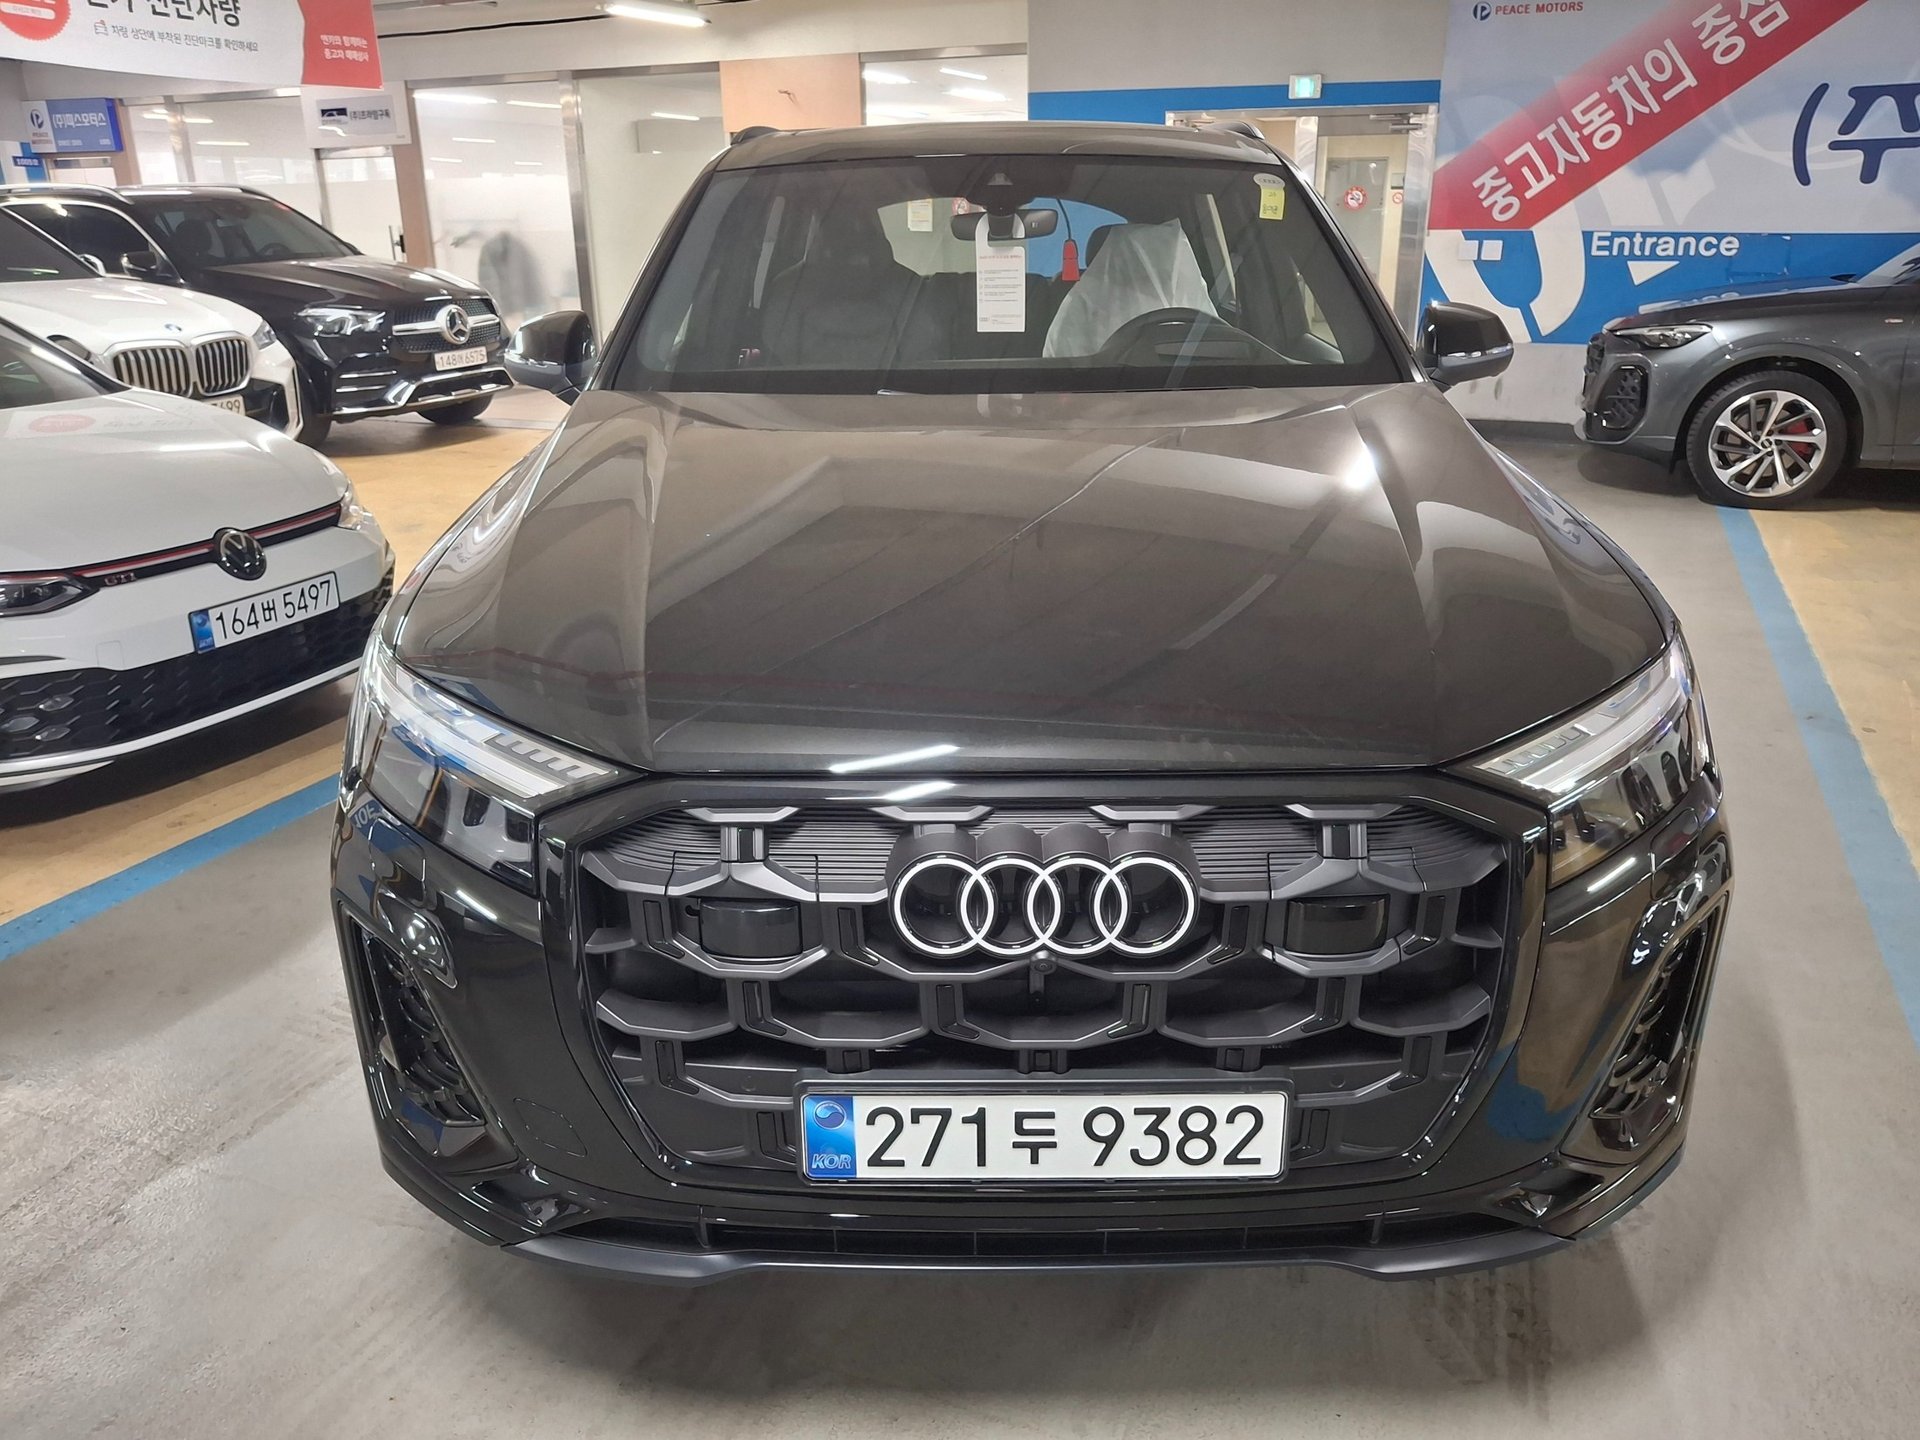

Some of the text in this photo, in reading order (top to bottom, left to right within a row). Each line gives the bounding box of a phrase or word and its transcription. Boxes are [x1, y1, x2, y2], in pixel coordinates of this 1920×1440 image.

[1495, 2, 1583, 15] PEACE MOTORS
[111, 25, 129, 39] 차량
[1472, 38, 1698, 222] 중고자동차의
[1591, 231, 1740, 258] Entrance
[104, 572, 137, 586] GTI
[283, 580, 331, 619] 5497
[866, 1105, 1265, 1168] 271두 9382
[811, 1153, 852, 1169] KOR
